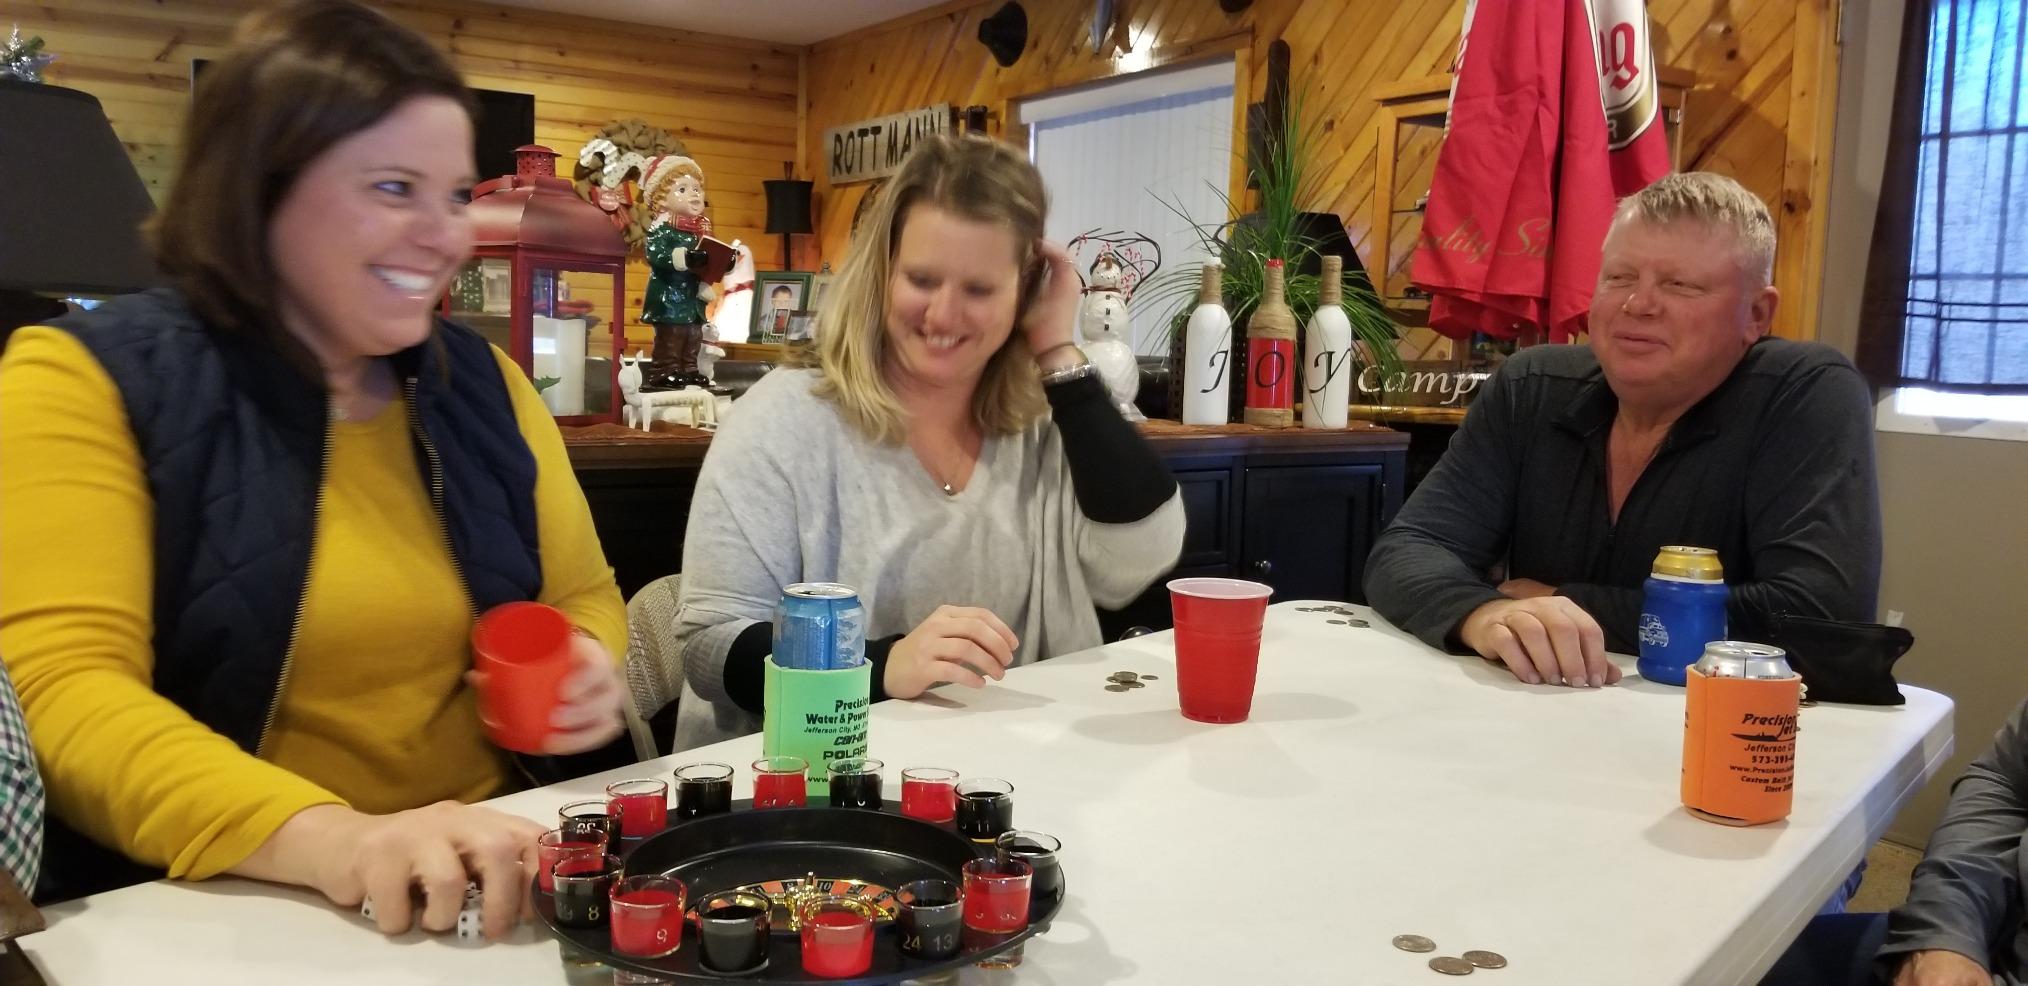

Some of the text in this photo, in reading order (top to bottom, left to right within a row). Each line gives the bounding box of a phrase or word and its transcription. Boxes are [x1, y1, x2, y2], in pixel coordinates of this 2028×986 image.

[806, 713, 838, 725] Water
[839, 713, 846, 723] &
[804, 726, 837, 734] Jefferson
[823, 745, 868, 760] POLARI
[1744, 744, 1787, 752] Jefferson
[818, 880, 832, 892] 10
[588, 905, 600, 921] 8
[902, 933, 921, 951] 24
